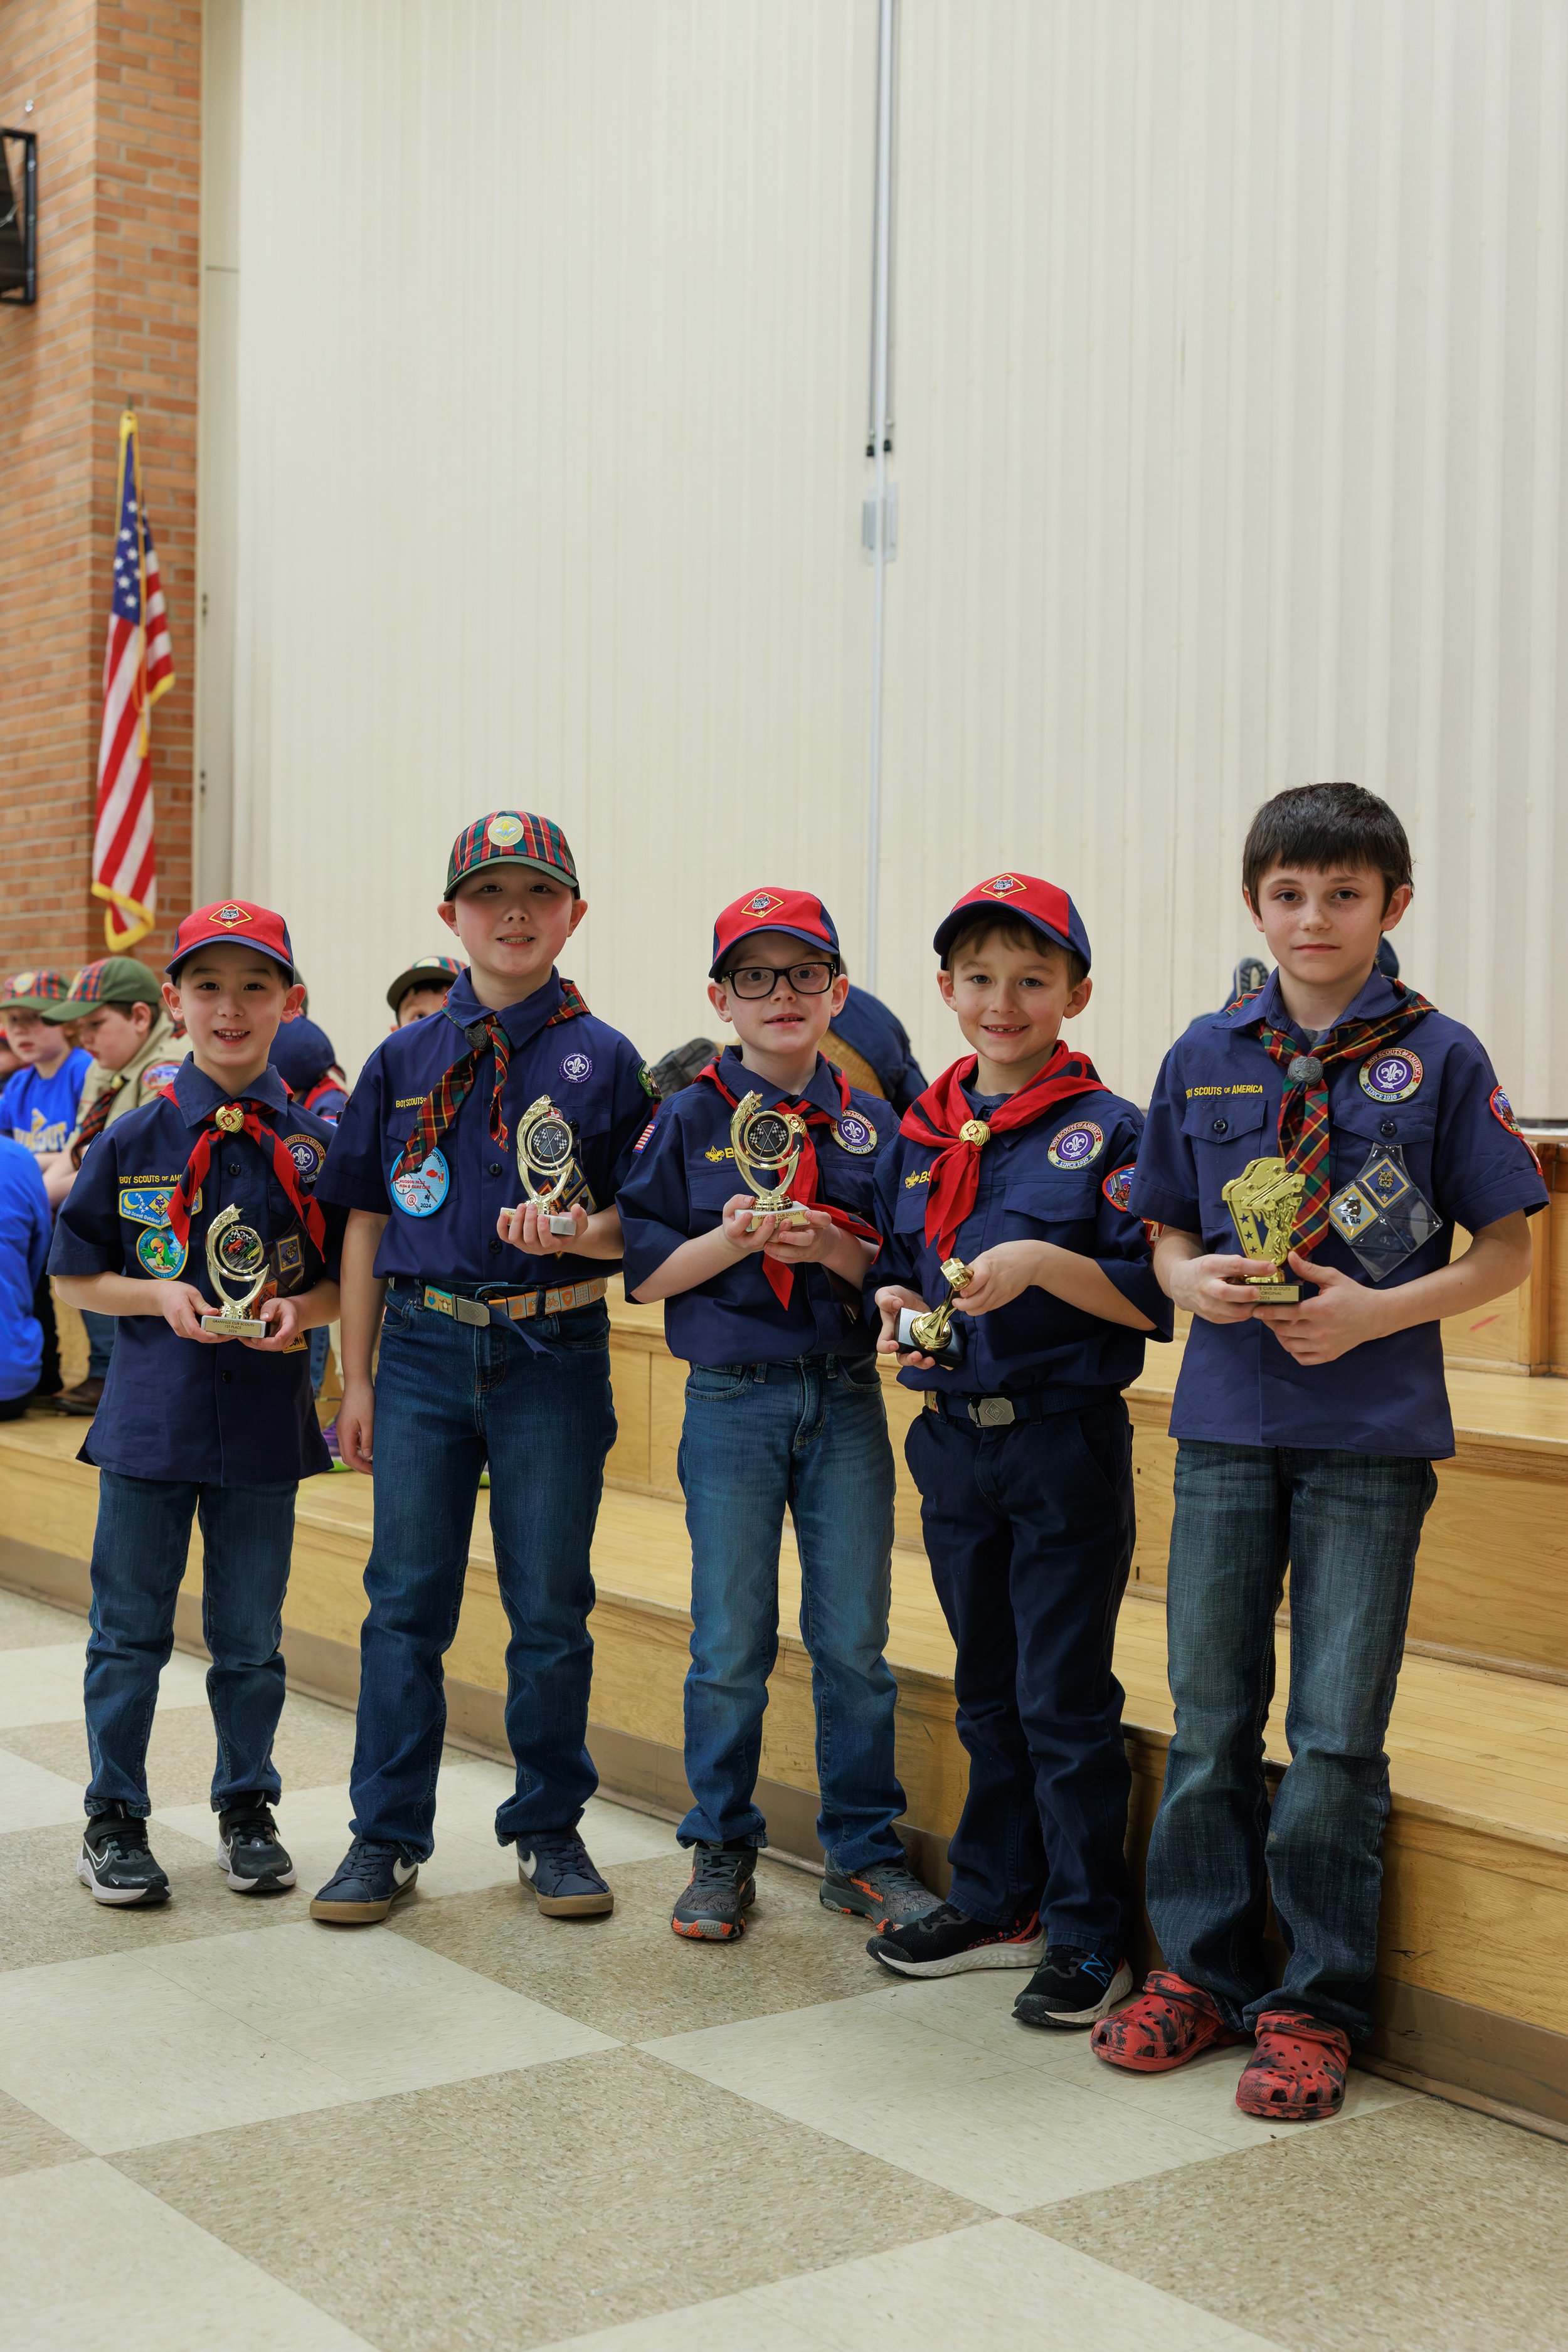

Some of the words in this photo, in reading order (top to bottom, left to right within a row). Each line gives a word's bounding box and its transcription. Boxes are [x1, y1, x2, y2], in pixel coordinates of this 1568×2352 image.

[1367, 1055, 1378, 1065] BOY
[1379, 1049, 1402, 1057] SCOUTS
[1407, 1055, 1421, 1078] AMERICA
[1194, 1087, 1222, 1096] SCOUTS
[1231, 1084, 1263, 1094] AMERICA
[1367, 1086, 1383, 1098] SINCE
[396, 1099, 406, 1108] BOY
[406, 1096, 424, 1106] SCOUTS
[1058, 1125, 1078, 1138] SCOUTS
[1083, 1123, 1101, 1140] AMERICA
[284, 1136, 300, 1148] SCOUTS
[305, 1138, 324, 1157] AMERICA
[1076, 1157, 1089, 1166] 1910
[119, 1175, 132, 1184] BOY
[133, 1175, 160, 1184] SCOUTS
[130, 1211, 144, 1219] Scout
[144, 1214, 161, 1224] Outdoor
